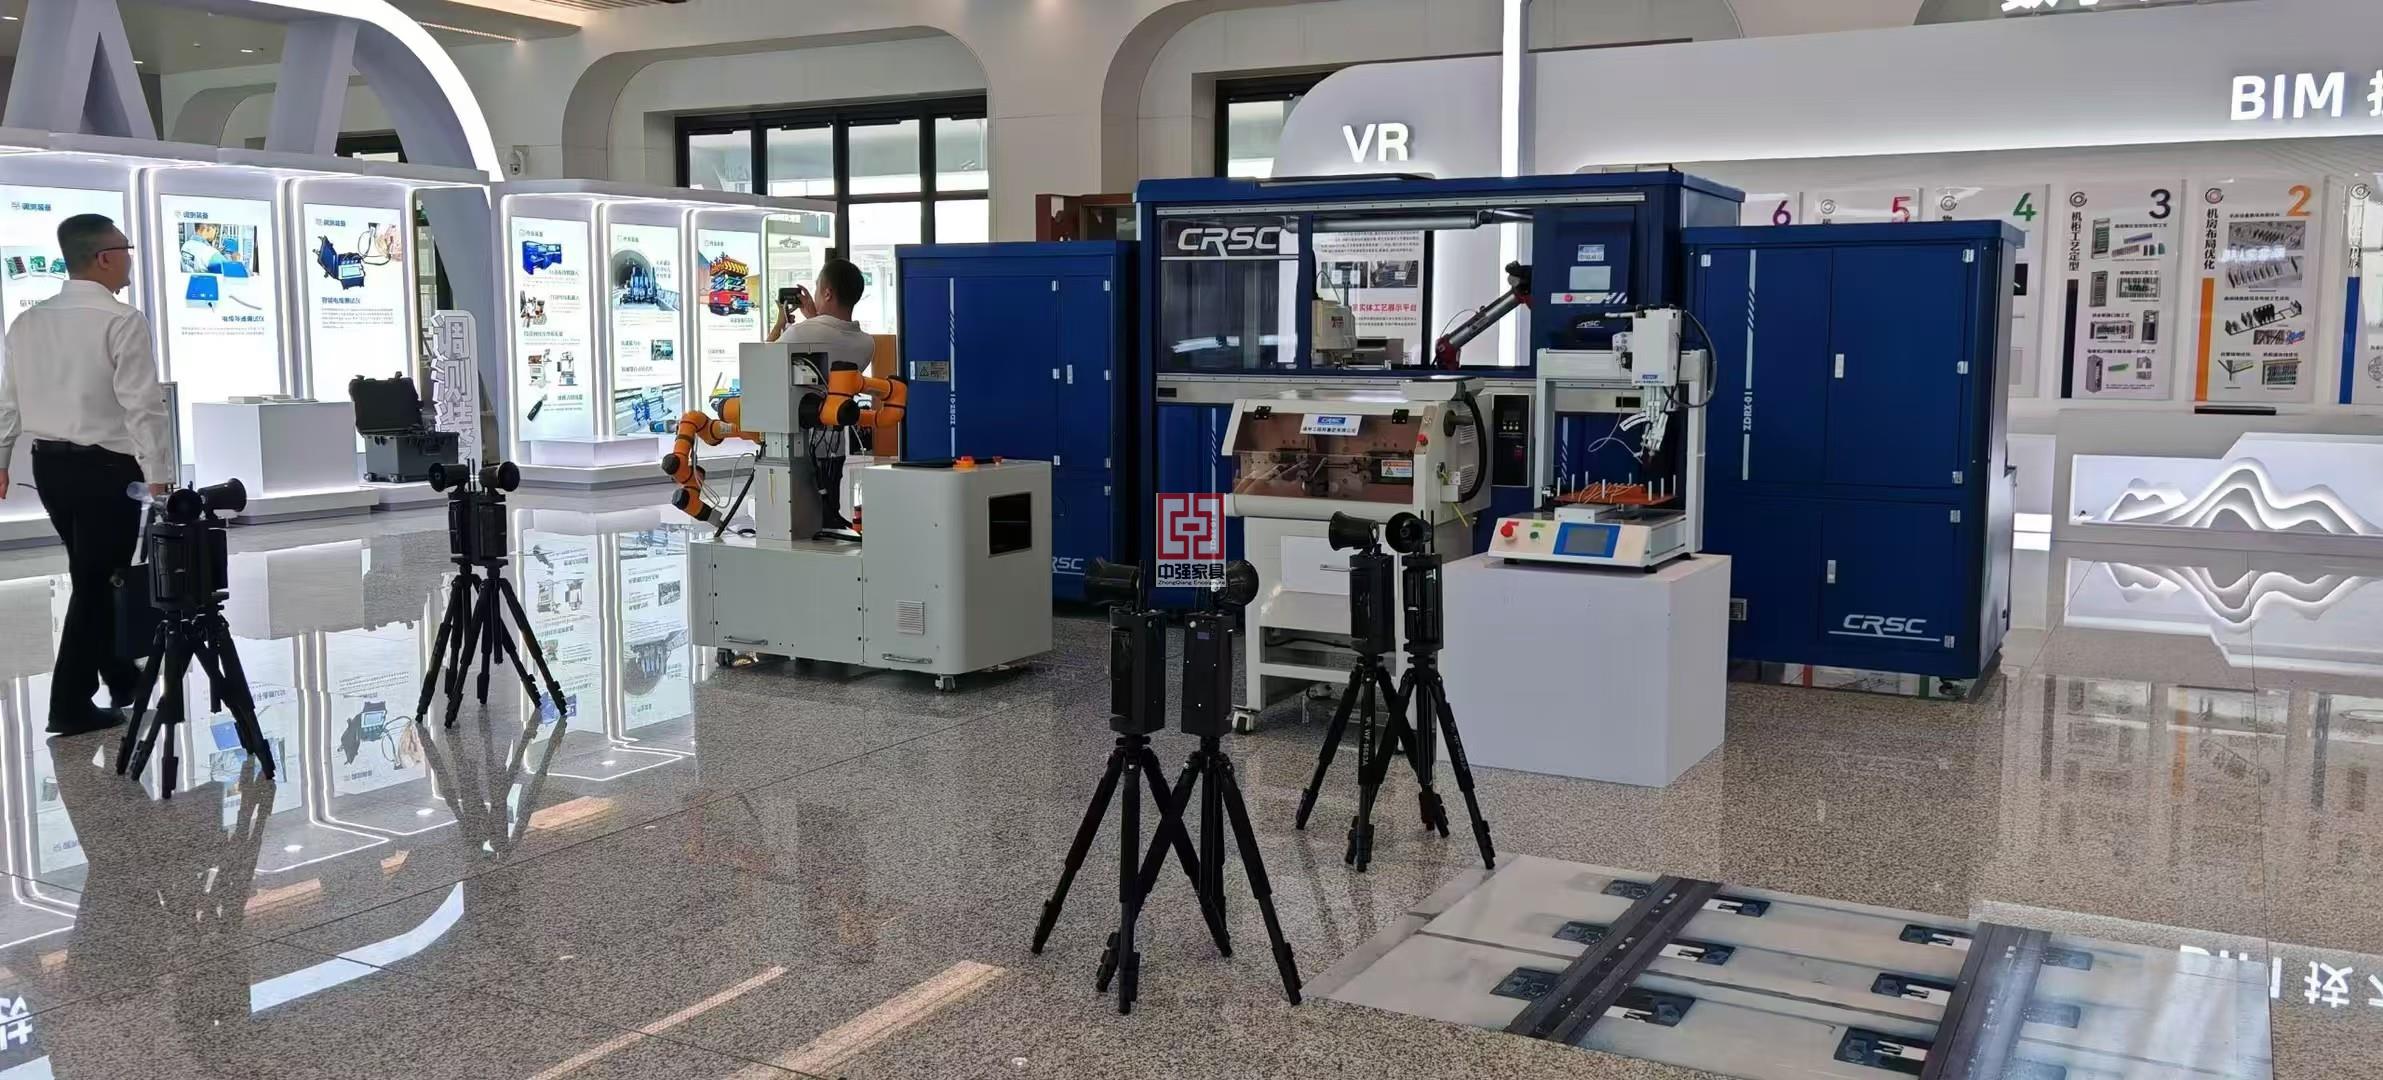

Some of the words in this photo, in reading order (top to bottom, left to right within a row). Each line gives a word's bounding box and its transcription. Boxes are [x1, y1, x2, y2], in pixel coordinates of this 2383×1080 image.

[2230, 72, 2345, 121] BIM
[1342, 122, 1409, 163] VR
[1772, 200, 1792, 225] 6
[1892, 196, 1911, 223] 5
[2012, 192, 2037, 222] 4
[2149, 188, 2171, 219] 3
[2286, 184, 2312, 217] 2
[1178, 226, 1282, 257] CRSC
[1843, 614, 1927, 636] CRSC
